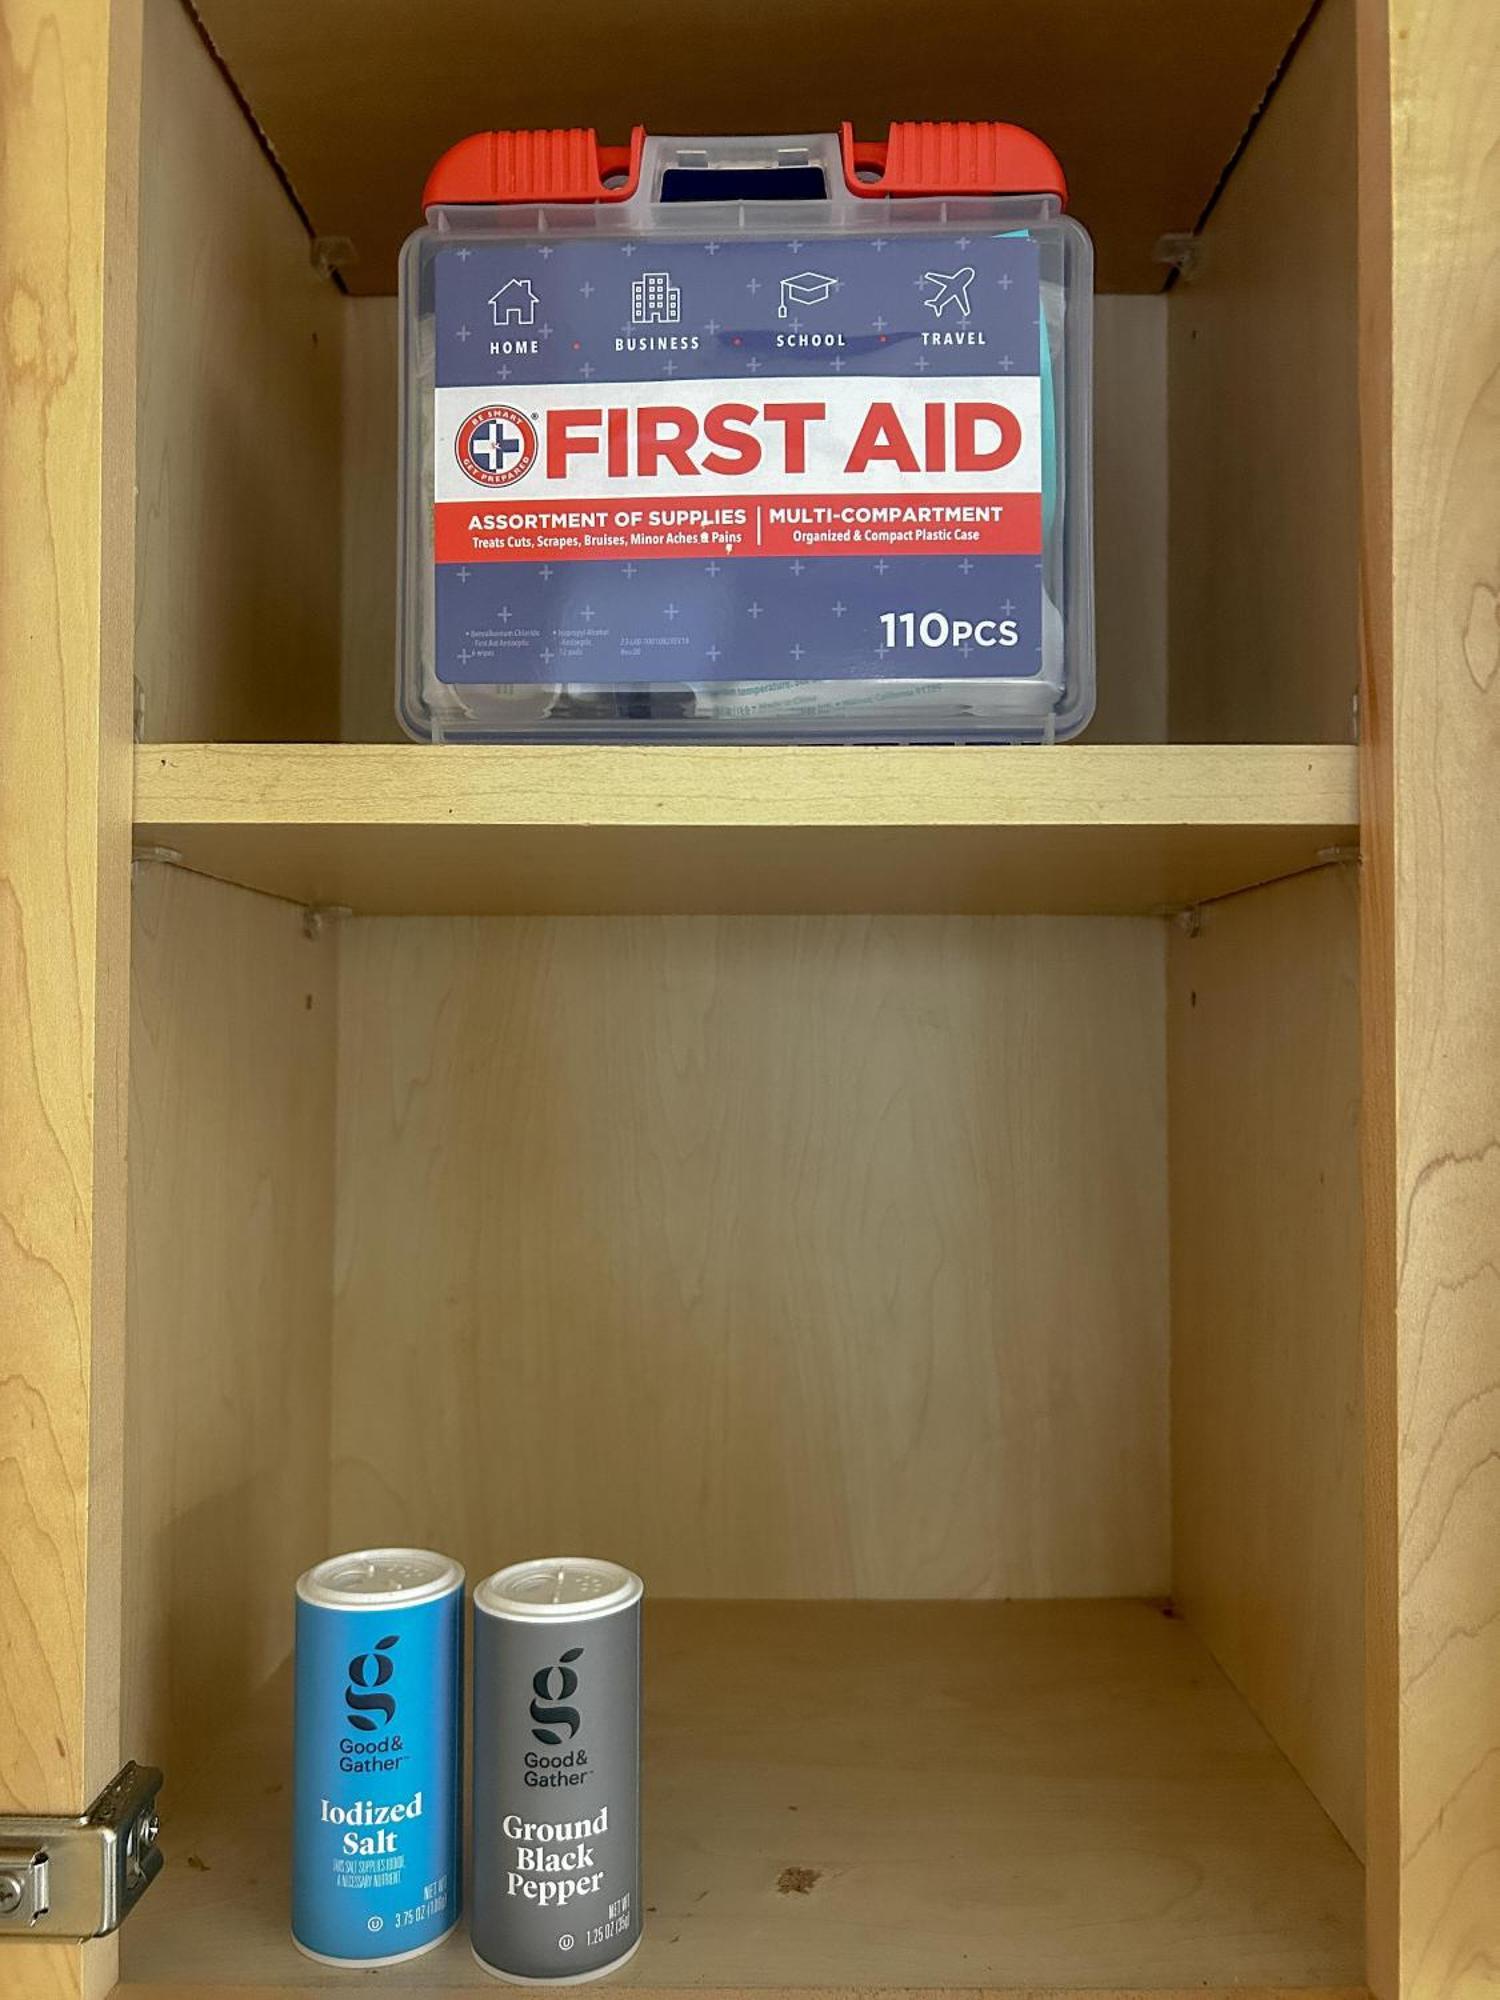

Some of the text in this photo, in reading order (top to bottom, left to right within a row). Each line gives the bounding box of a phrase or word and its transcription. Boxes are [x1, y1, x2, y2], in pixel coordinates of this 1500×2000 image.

[490, 340, 539, 354] HOME
[615, 337, 699, 351] BUSINESS
[776, 333, 846, 347] SCHOOL
[921, 332, 986, 345] TRAVEL
[472, 410, 523, 426] BE SMART
[546, 402, 1022, 479] FIRST AID
[463, 457, 529, 482] GET PREPARED
[468, 509, 747, 530] ASSORTMENT OF SUPPLIES
[769, 506, 1003, 523] MULTI-COMPARTMENT
[472, 537, 504, 549] Treats
[507, 536, 535, 549] Cuts,
[537, 535, 581, 550] Scrapes,
[584, 534, 628, 548] Bruises,
[631, 533, 664, 545] Minor
[666, 532, 698, 544] Aches
[712, 531, 742, 543] Pains
[793, 528, 980, 544] Organized & Compact Plastic Case
[320, 1791, 422, 1826] Iodized
[503, 1806, 609, 1842] Ground
[343, 1829, 398, 1855] Salt
[516, 1842, 594, 1872] Black
[507, 1871, 604, 1906] Pepper
[395, 1908, 413, 1928] 3.75
[415, 1904, 425, 1922] OZ
[587, 1926, 603, 1946] 1.25
